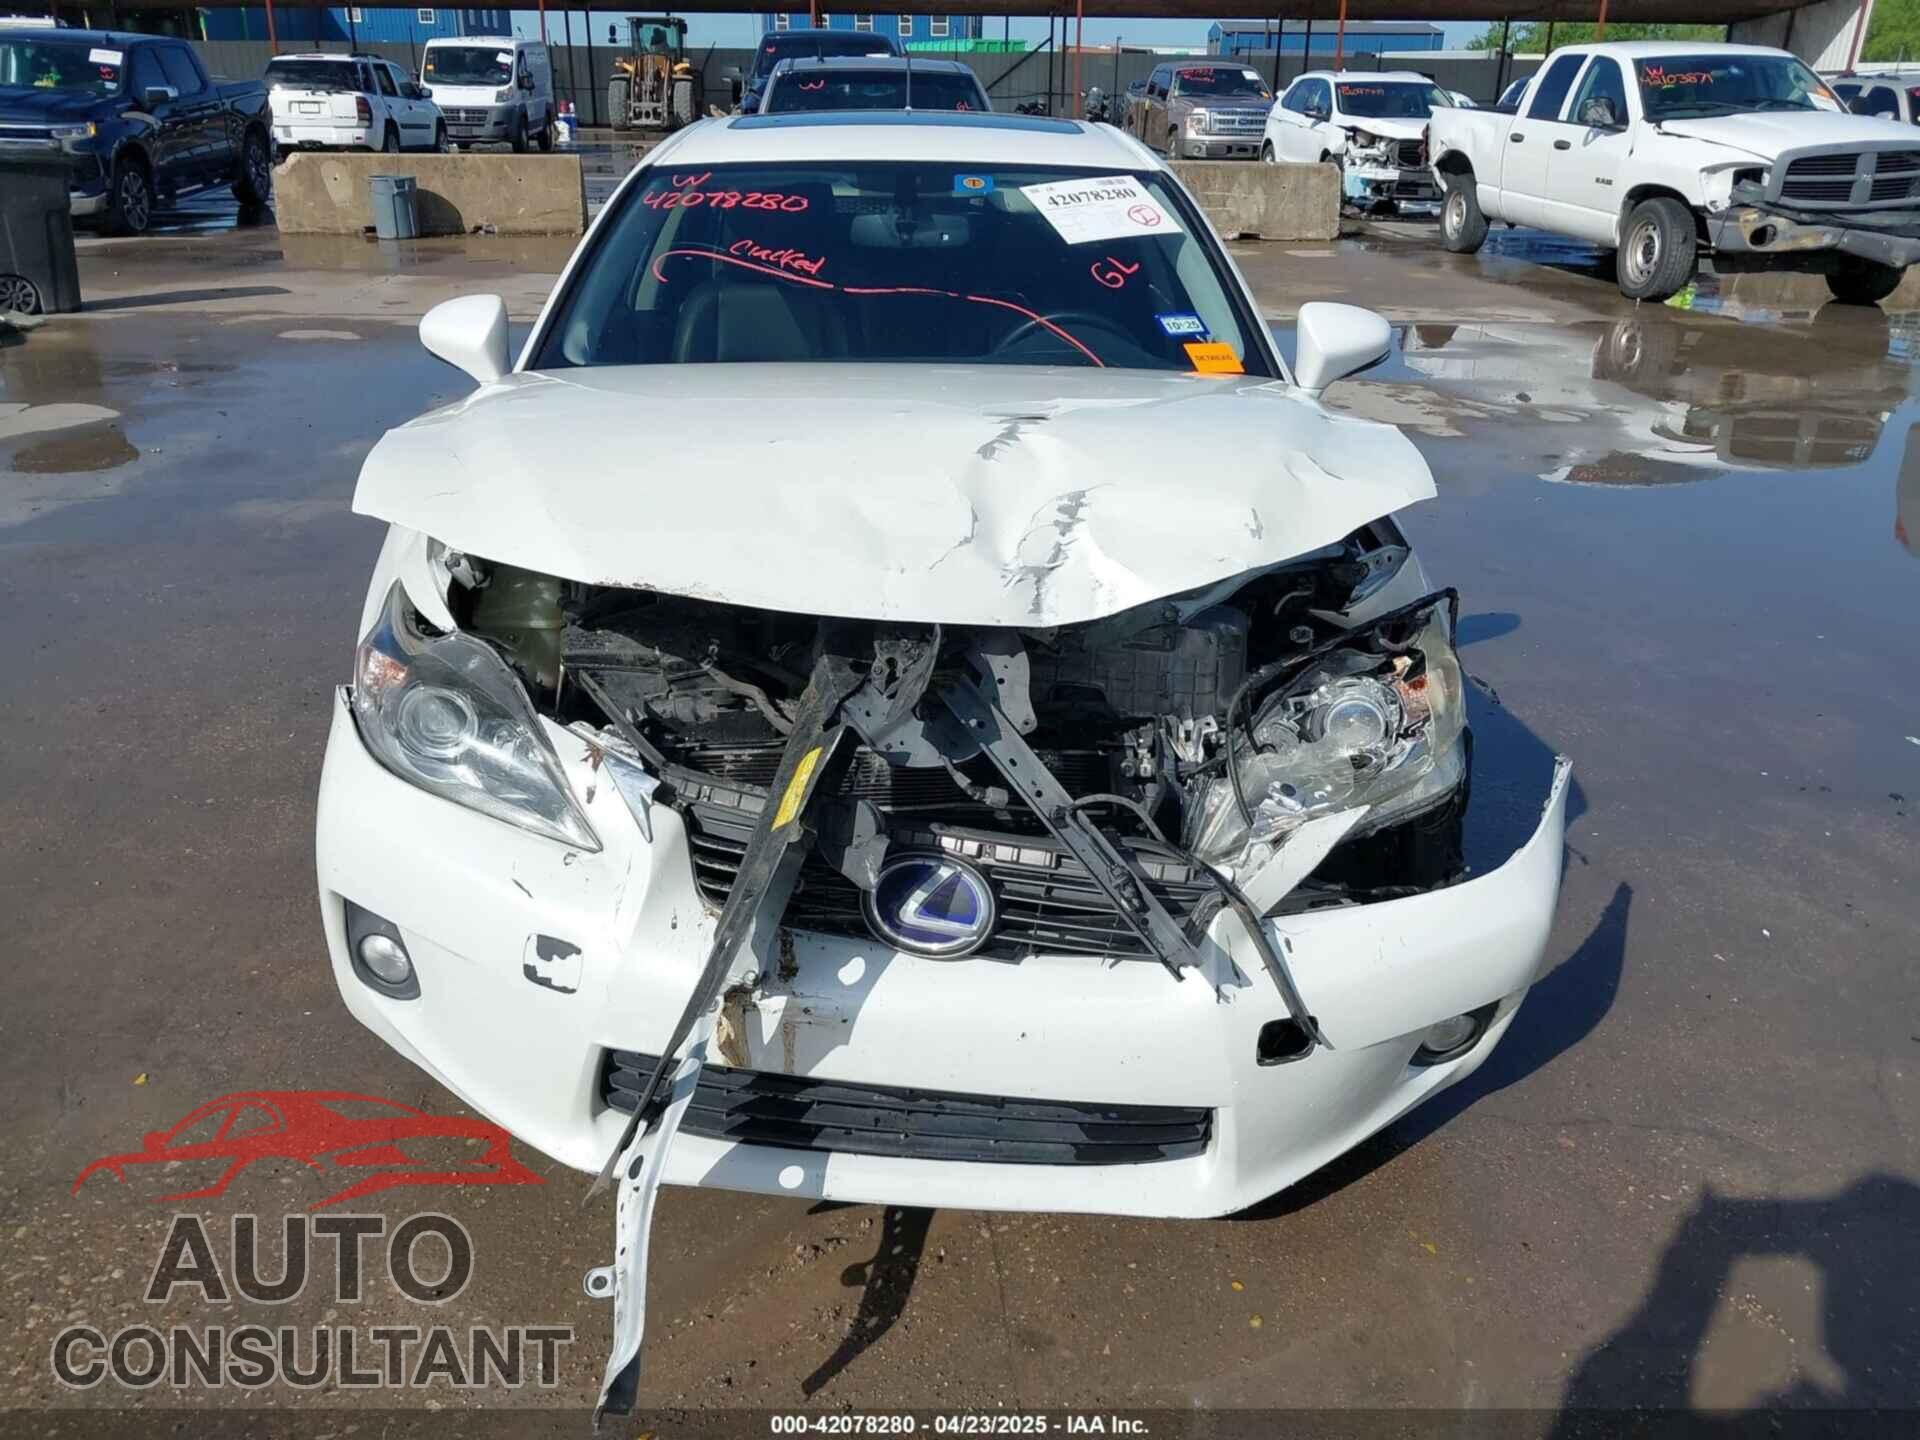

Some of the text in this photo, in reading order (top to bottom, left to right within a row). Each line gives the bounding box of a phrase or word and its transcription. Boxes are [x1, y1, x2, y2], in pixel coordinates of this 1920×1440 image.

[672, 171, 712, 188] W
[642, 190, 809, 212] 42078280
[1047, 187, 1137, 207] 42078280
